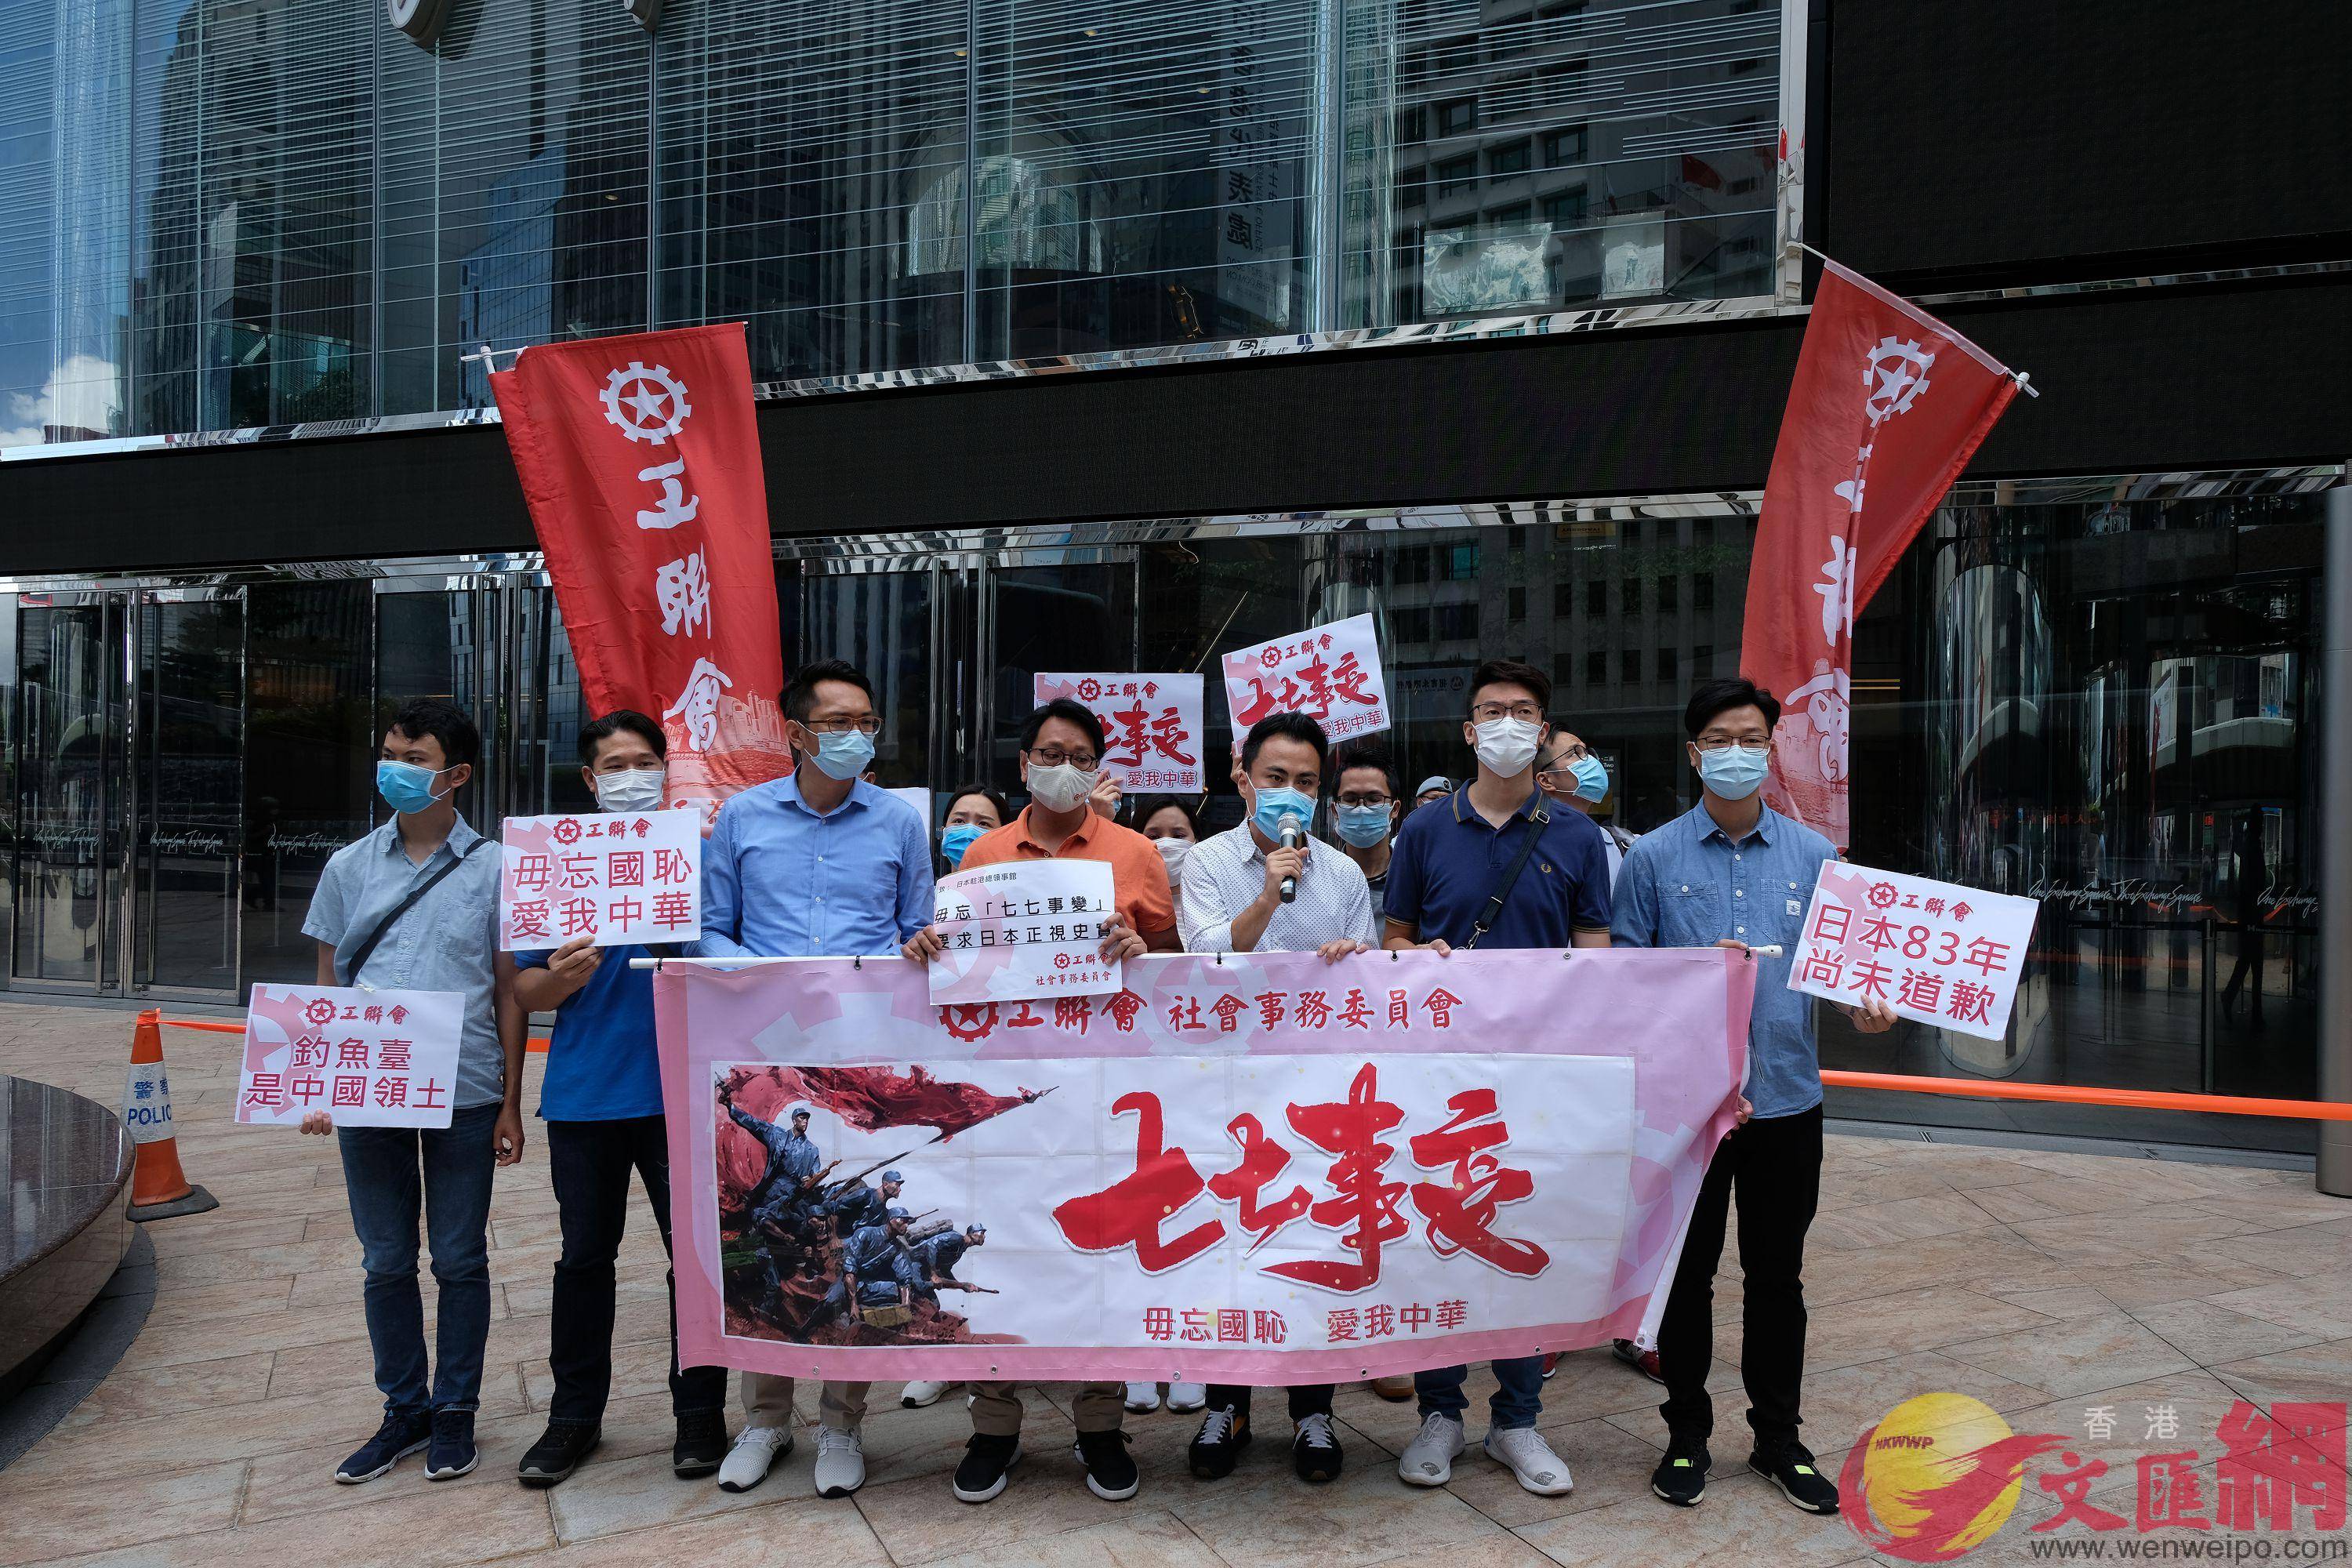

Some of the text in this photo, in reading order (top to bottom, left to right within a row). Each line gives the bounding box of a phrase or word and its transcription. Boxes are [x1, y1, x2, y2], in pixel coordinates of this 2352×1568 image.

[637, 455, 733, 752] 工聯會
[1285, 633, 1334, 659] 工聯會
[1104, 681, 1160, 699] 工聯會
[1320, 709, 1385, 738] 愛我中華
[1126, 770, 1198, 788] 愛我中華
[586, 818, 653, 840] 工聯會
[512, 848, 693, 893] 毋忘國恥
[511, 891, 692, 939] 愛我中華
[1900, 893, 1974, 923] 工聯會
[1813, 903, 2012, 977] 日本83年
[1036, 971, 1112, 986] 社會事務委員會
[1801, 947, 1997, 1027] 尚未道歉
[339, 1004, 411, 1025] 工聯會
[1007, 987, 1463, 1035] 工聯會 社會事務委員會
[292, 1035, 413, 1071] 釣魚臺
[134, 1076, 169, 1099] 警察
[245, 1073, 446, 1109] 是中國領土
[1326, 1299, 1469, 1345] 愛我中華
